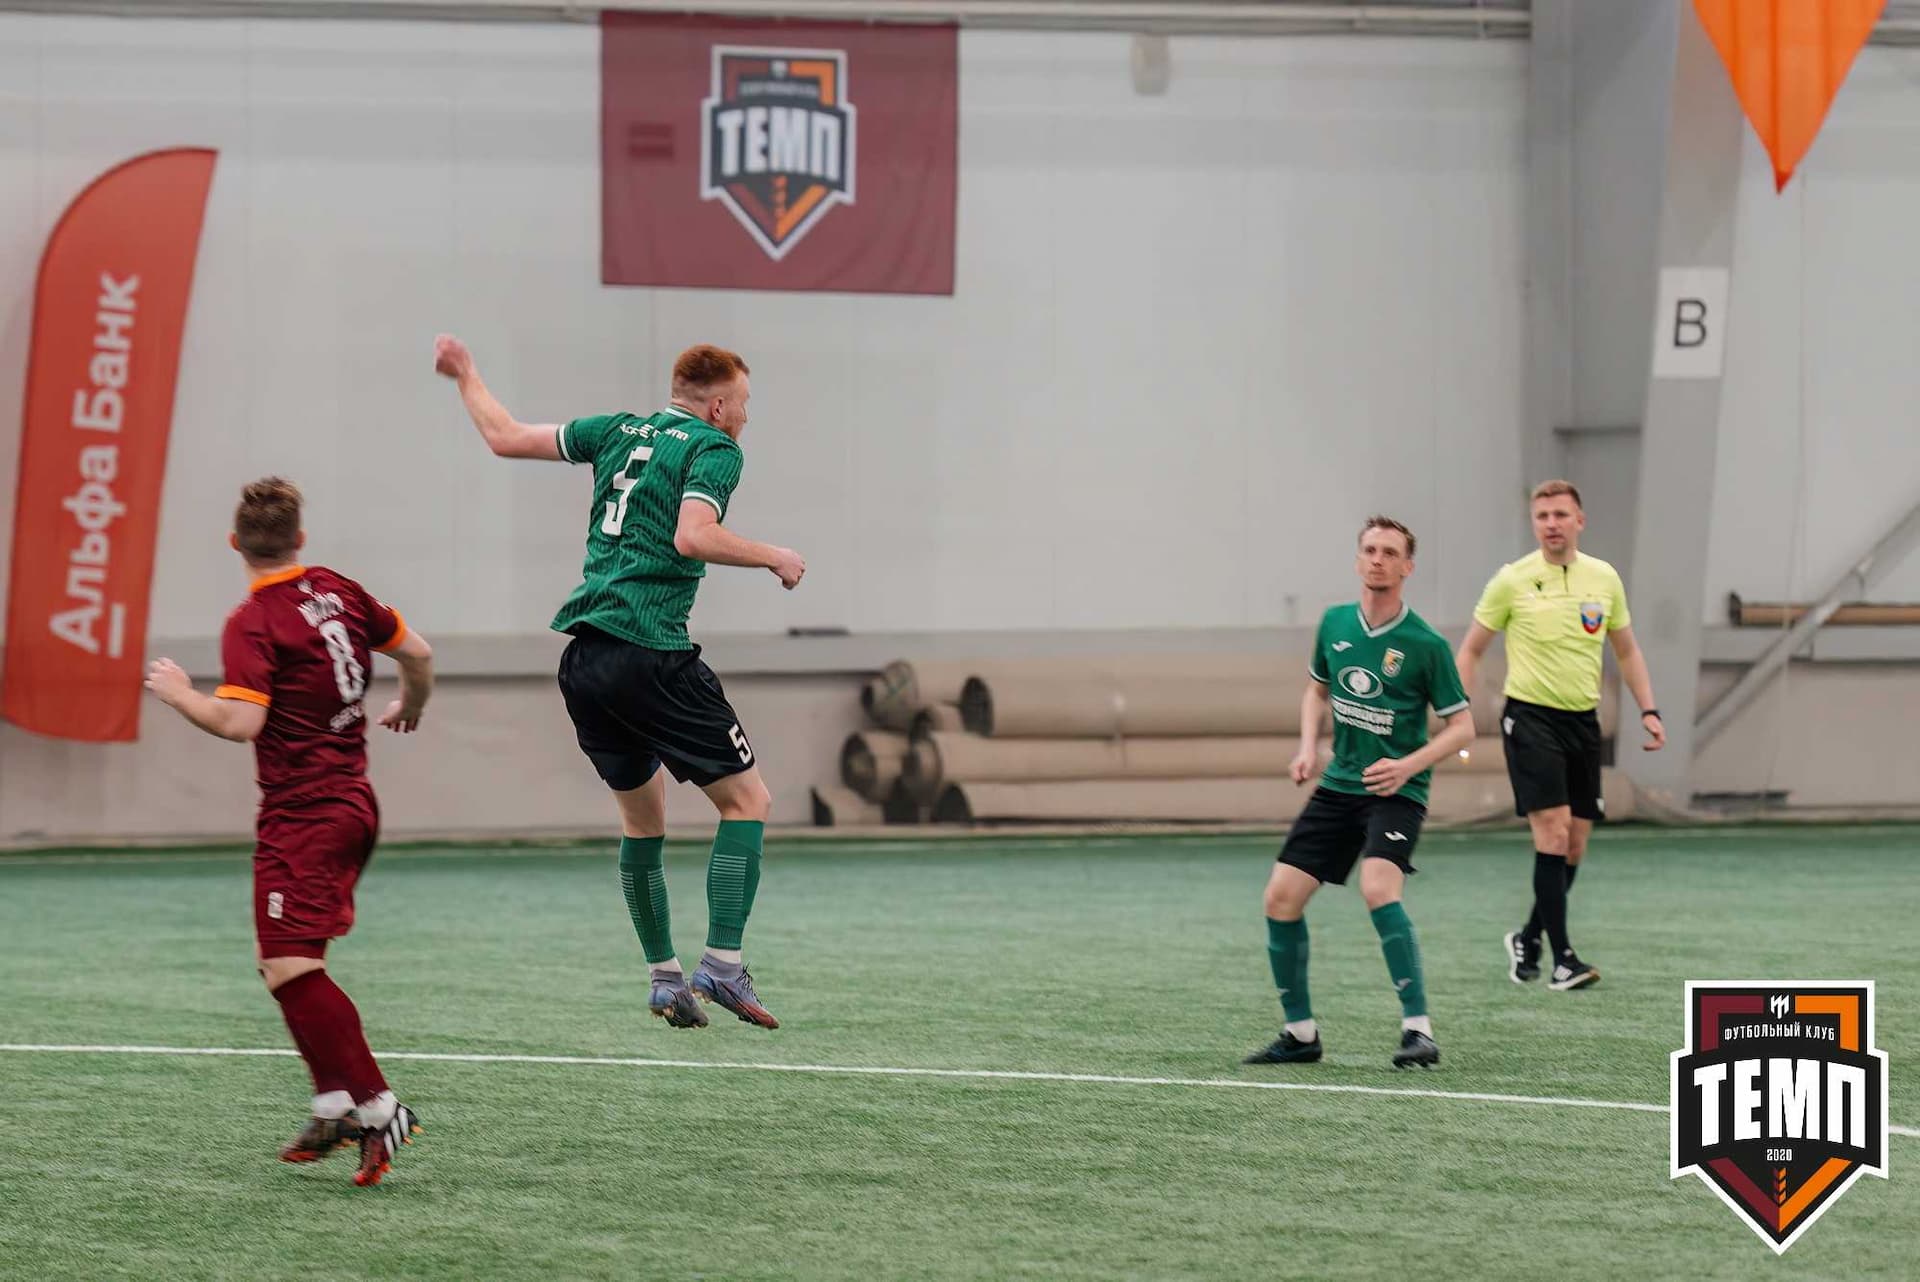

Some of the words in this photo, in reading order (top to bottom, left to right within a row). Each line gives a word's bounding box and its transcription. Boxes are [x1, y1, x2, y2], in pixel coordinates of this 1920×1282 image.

[717, 106, 841, 182] ТЕМП
[72, 272, 140, 433] Банк
[601, 446, 654, 536] 5
[48, 445, 127, 654] Альфа
[728, 723, 753, 764] 5
